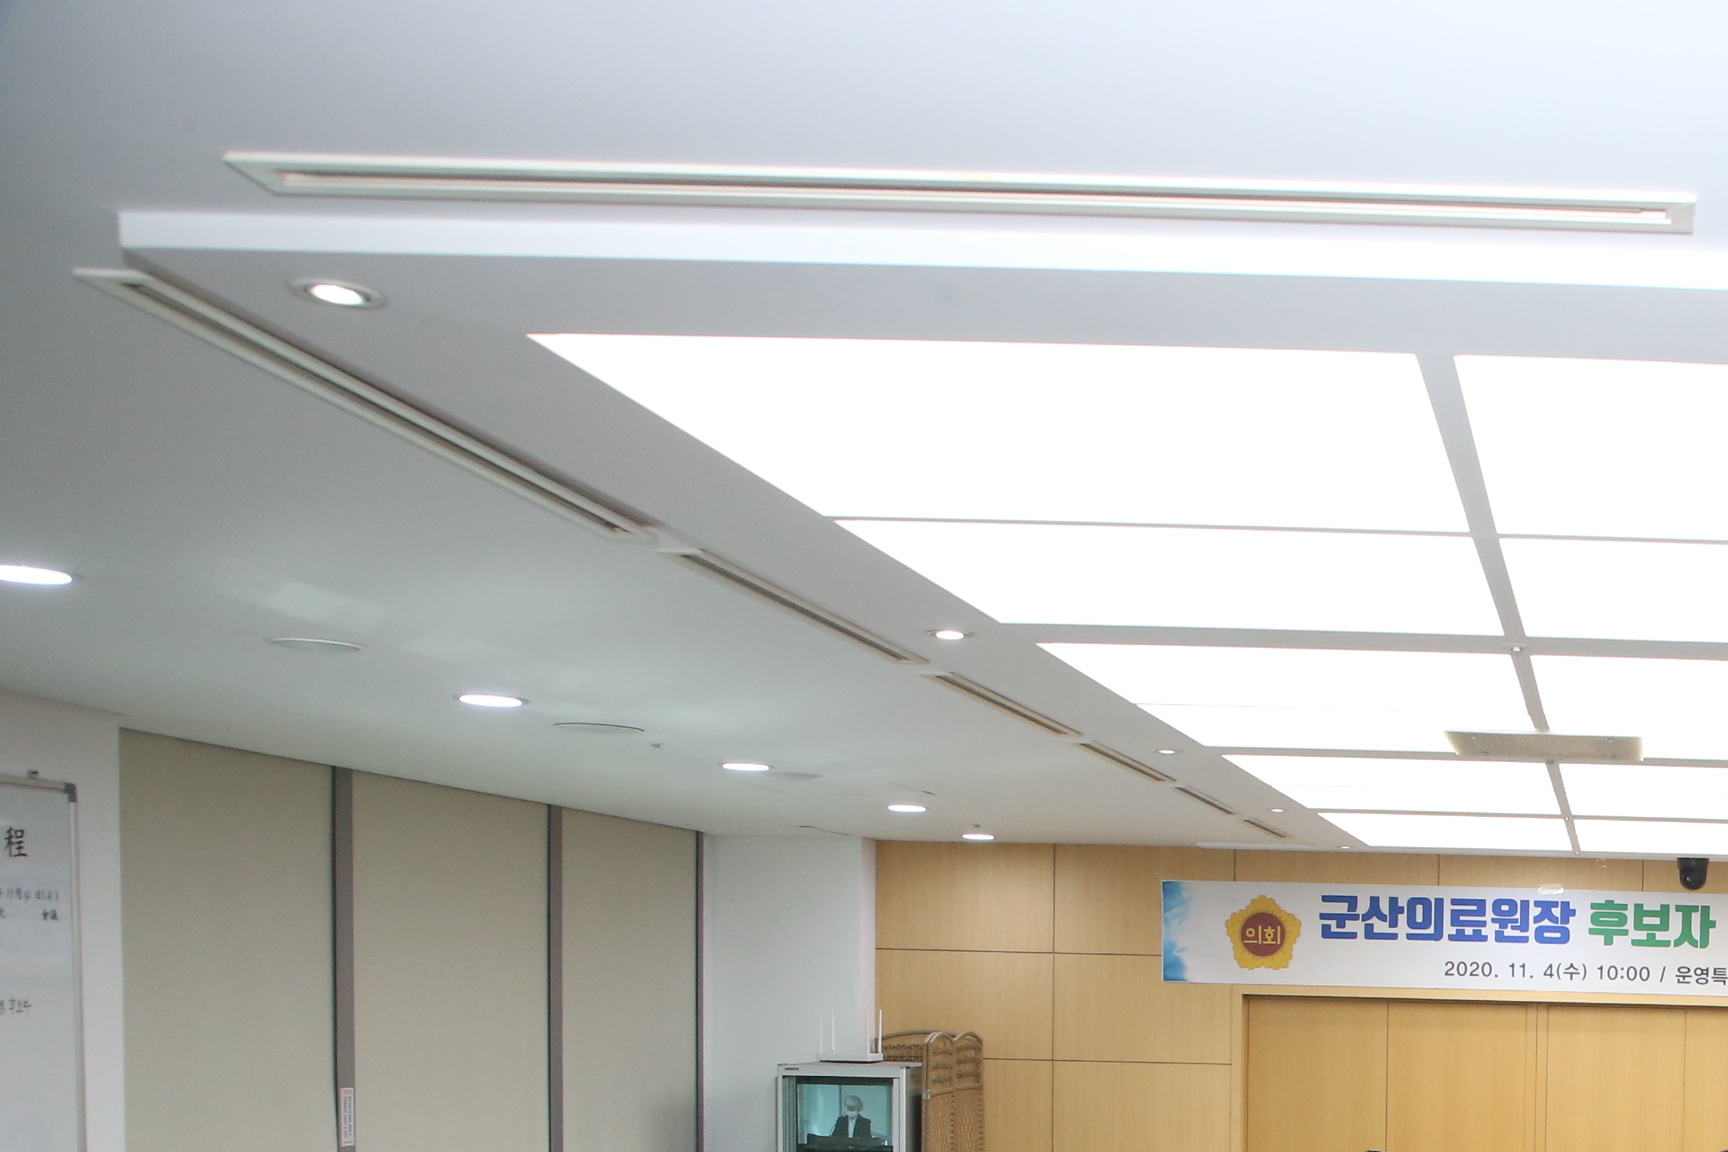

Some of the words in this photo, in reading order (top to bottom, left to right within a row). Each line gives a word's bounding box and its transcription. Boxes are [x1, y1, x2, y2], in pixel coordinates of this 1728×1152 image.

[4, 827, 28, 858] 程
[1318, 894, 1576, 945] 군산의료원장
[1587, 899, 1716, 950] 후보자
[1244, 926, 1283, 947] 의회
[1444, 961, 1499, 979] 2020.
[1509, 963, 1534, 979] 11.
[1543, 963, 1588, 981] 4(수)
[1597, 965, 1650, 982] 10:00
